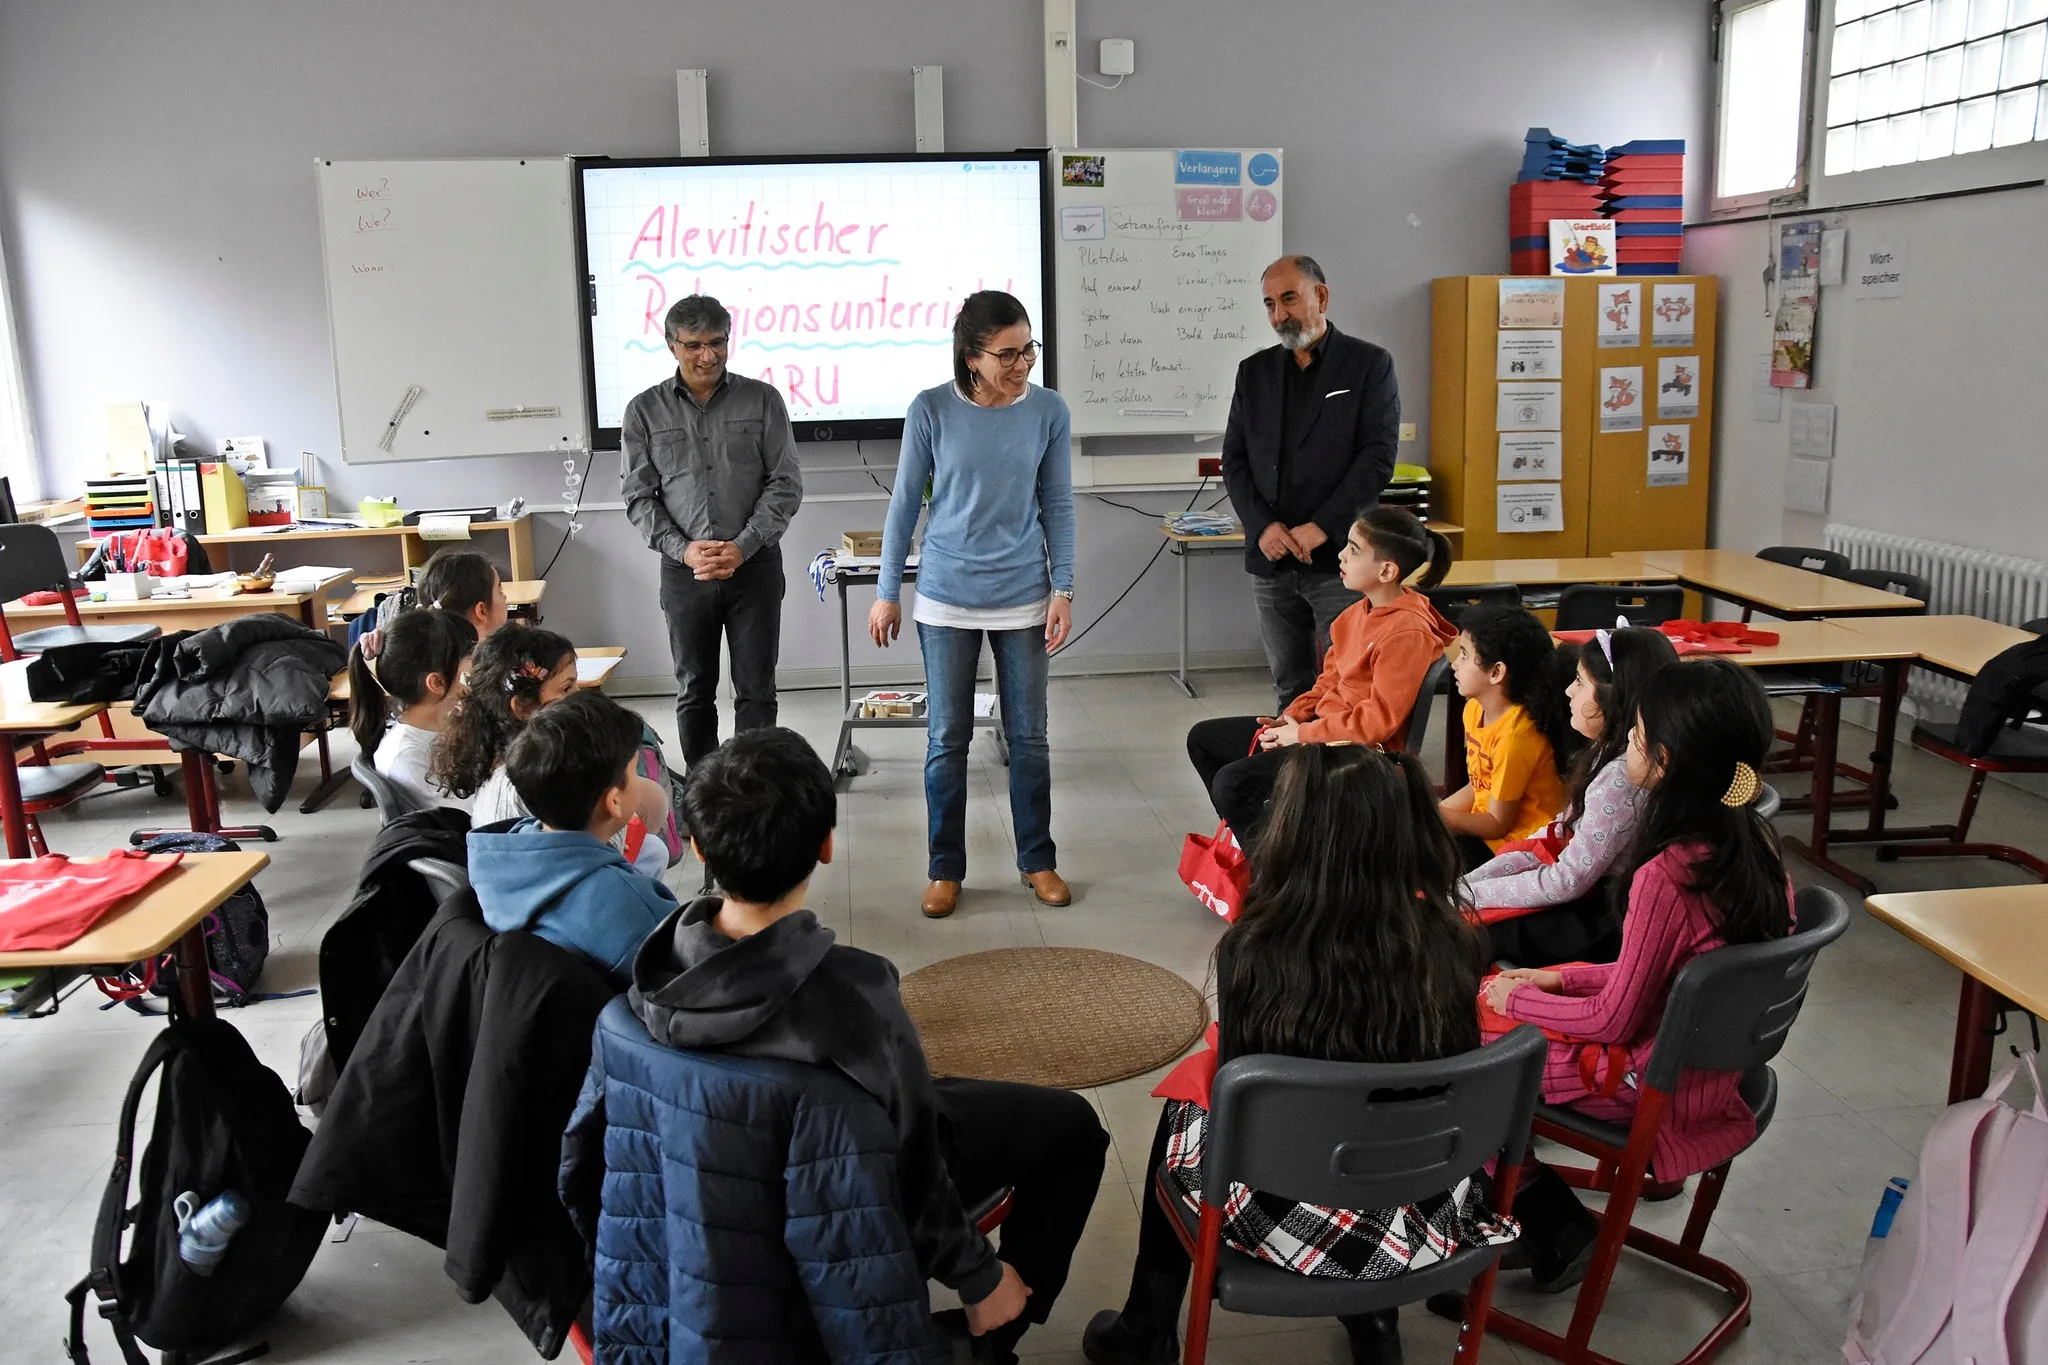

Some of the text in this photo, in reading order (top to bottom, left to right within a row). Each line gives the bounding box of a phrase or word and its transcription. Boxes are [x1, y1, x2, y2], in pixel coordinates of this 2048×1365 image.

[629, 200, 889, 260] Alevitischer
[1573, 222, 1612, 231] Garfield
[1197, 244, 1228, 263] Tages
[1869, 252, 1894, 264] Wort-
[1081, 276, 1142, 297] Auf einmal
[1861, 271, 1900, 286] speicher
[636, 274, 1013, 359] Rgionsunterri
[1150, 301, 1171, 315] Nach
[1178, 304, 1212, 322] einiger
[1084, 331, 1143, 349] Doch dann
[1212, 325, 1248, 343] darauf
[1117, 359, 1147, 379] letzten
[1083, 388, 1153, 404] Zum Schluss
